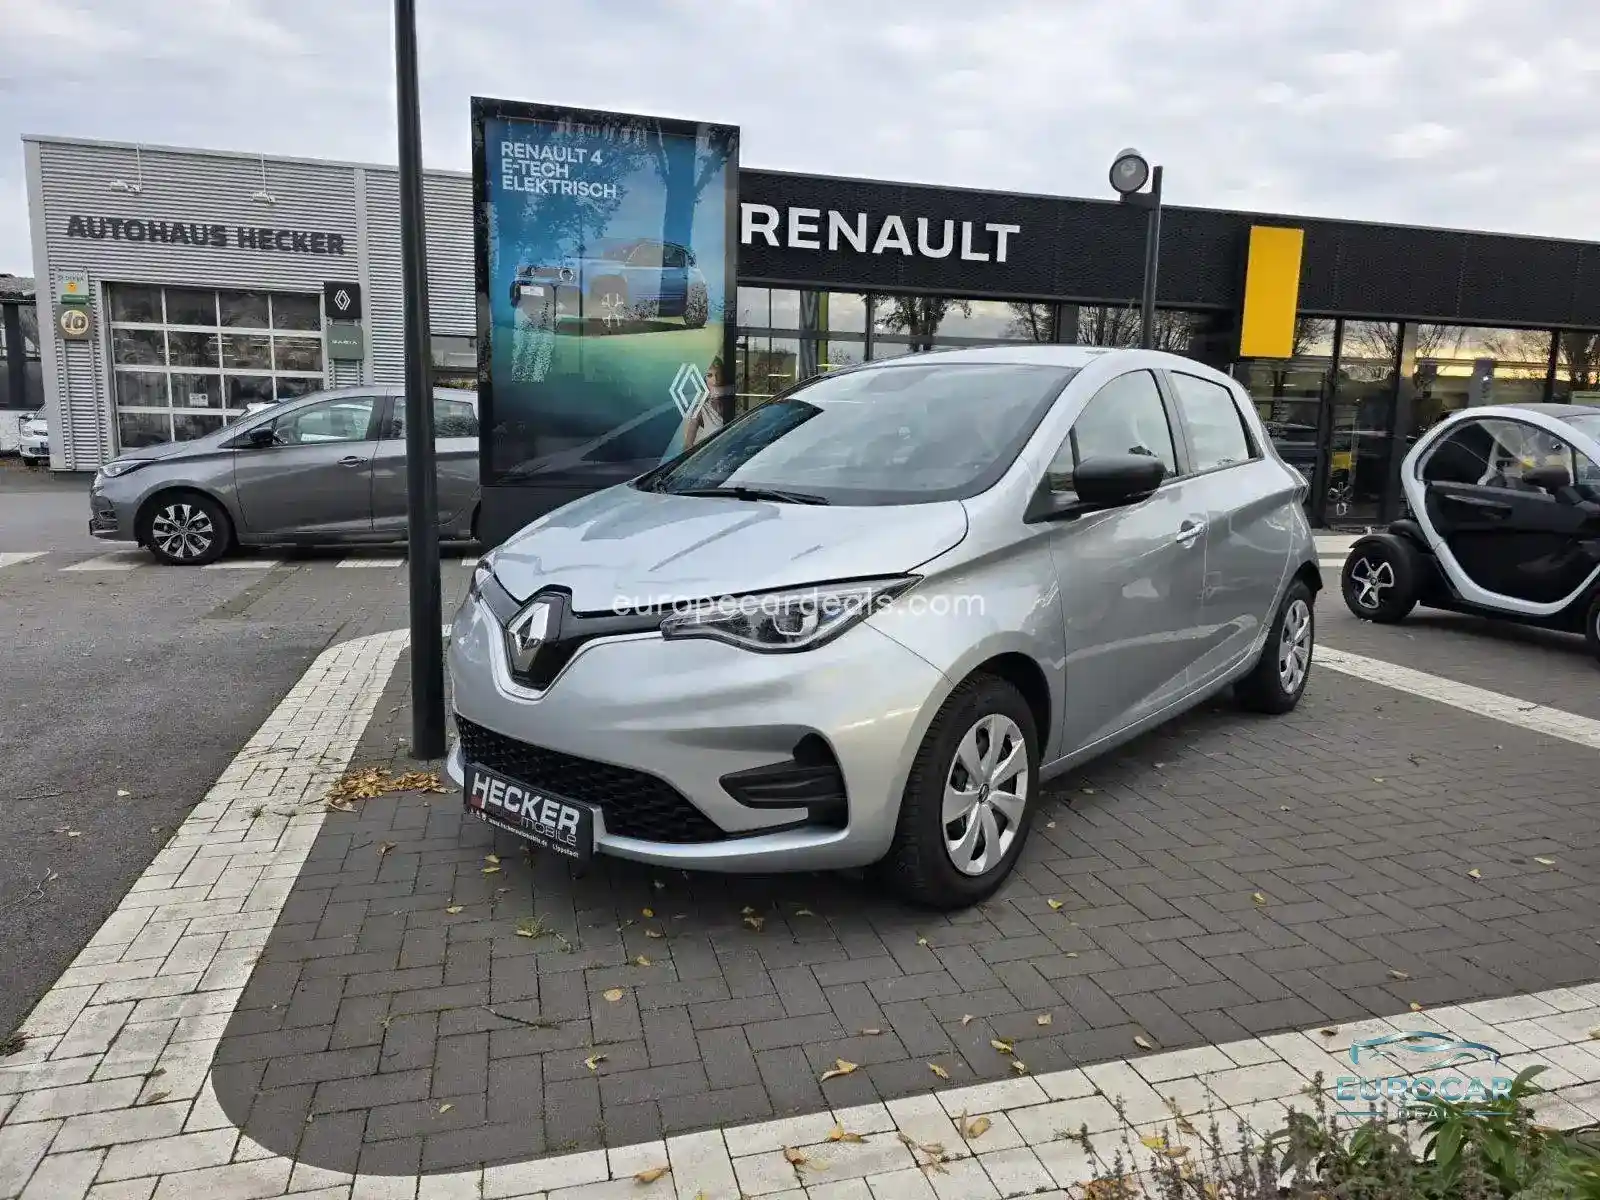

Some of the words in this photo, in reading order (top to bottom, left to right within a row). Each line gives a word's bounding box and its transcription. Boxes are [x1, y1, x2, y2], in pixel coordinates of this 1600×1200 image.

[500, 141, 587, 165] RENAULT
[590, 148, 603, 165] 4
[501, 159, 569, 179] E-TECH
[502, 174, 617, 199] ELEKTRISCH
[67, 214, 228, 248] AUTOHAUS
[237, 226, 345, 255] HECKER
[740, 202, 1021, 263] RENAULT
[472, 772, 580, 835] HECKER
[552, 843, 579, 859] Lippstadt
